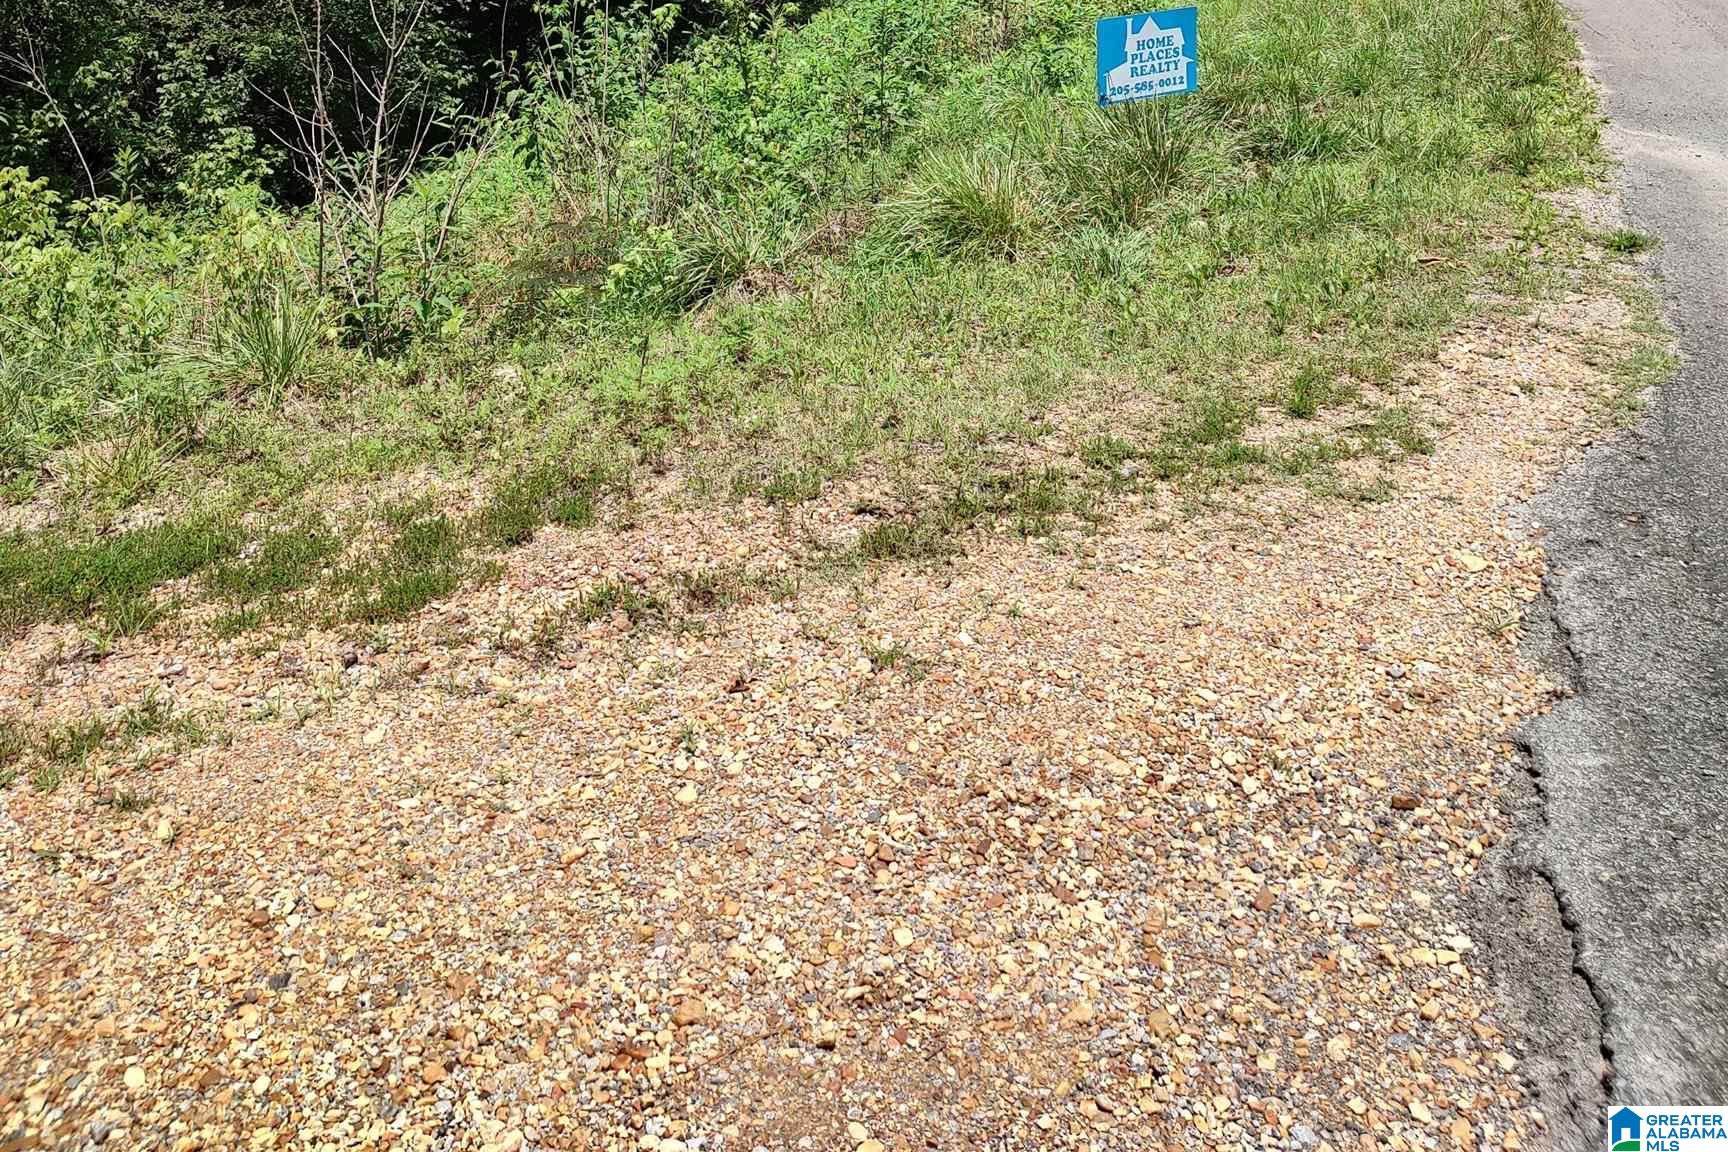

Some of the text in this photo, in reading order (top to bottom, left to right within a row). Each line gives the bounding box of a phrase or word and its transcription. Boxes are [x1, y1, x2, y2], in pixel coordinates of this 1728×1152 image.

[1136, 35, 1174, 51] HOME
[1130, 47, 1180, 65] PLACES
[1130, 59, 1181, 78] REALTY
